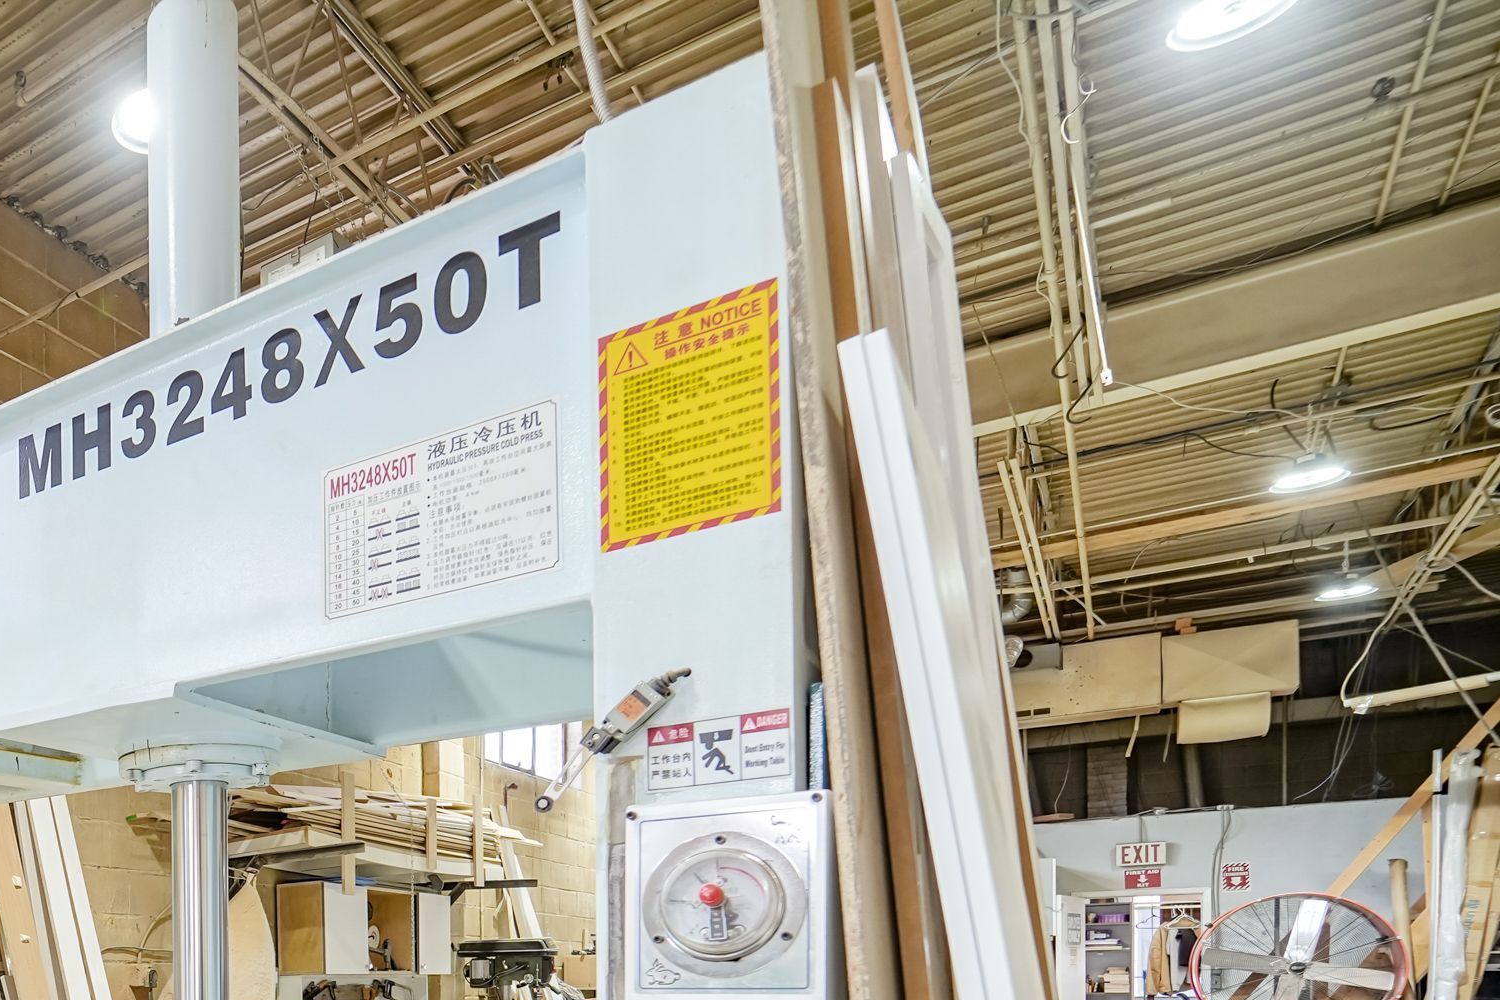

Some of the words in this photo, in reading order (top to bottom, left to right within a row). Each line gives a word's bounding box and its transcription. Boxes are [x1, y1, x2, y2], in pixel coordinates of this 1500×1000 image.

[700, 298, 762, 330] NOTICE
[18, 211, 560, 498] MH3248X50T
[428, 411, 542, 460] 液压冷压机
[428, 453, 464, 472] HYDRAULIC
[465, 442, 499, 462] PRESSURE
[500, 436, 519, 450] COLD
[520, 429, 544, 444] PRESS
[330, 453, 416, 499] MH3248X50T
[756, 712, 788, 728] DANGER
[652, 752, 691, 765] 工作台内
[1121, 844, 1160, 864] EXIT
